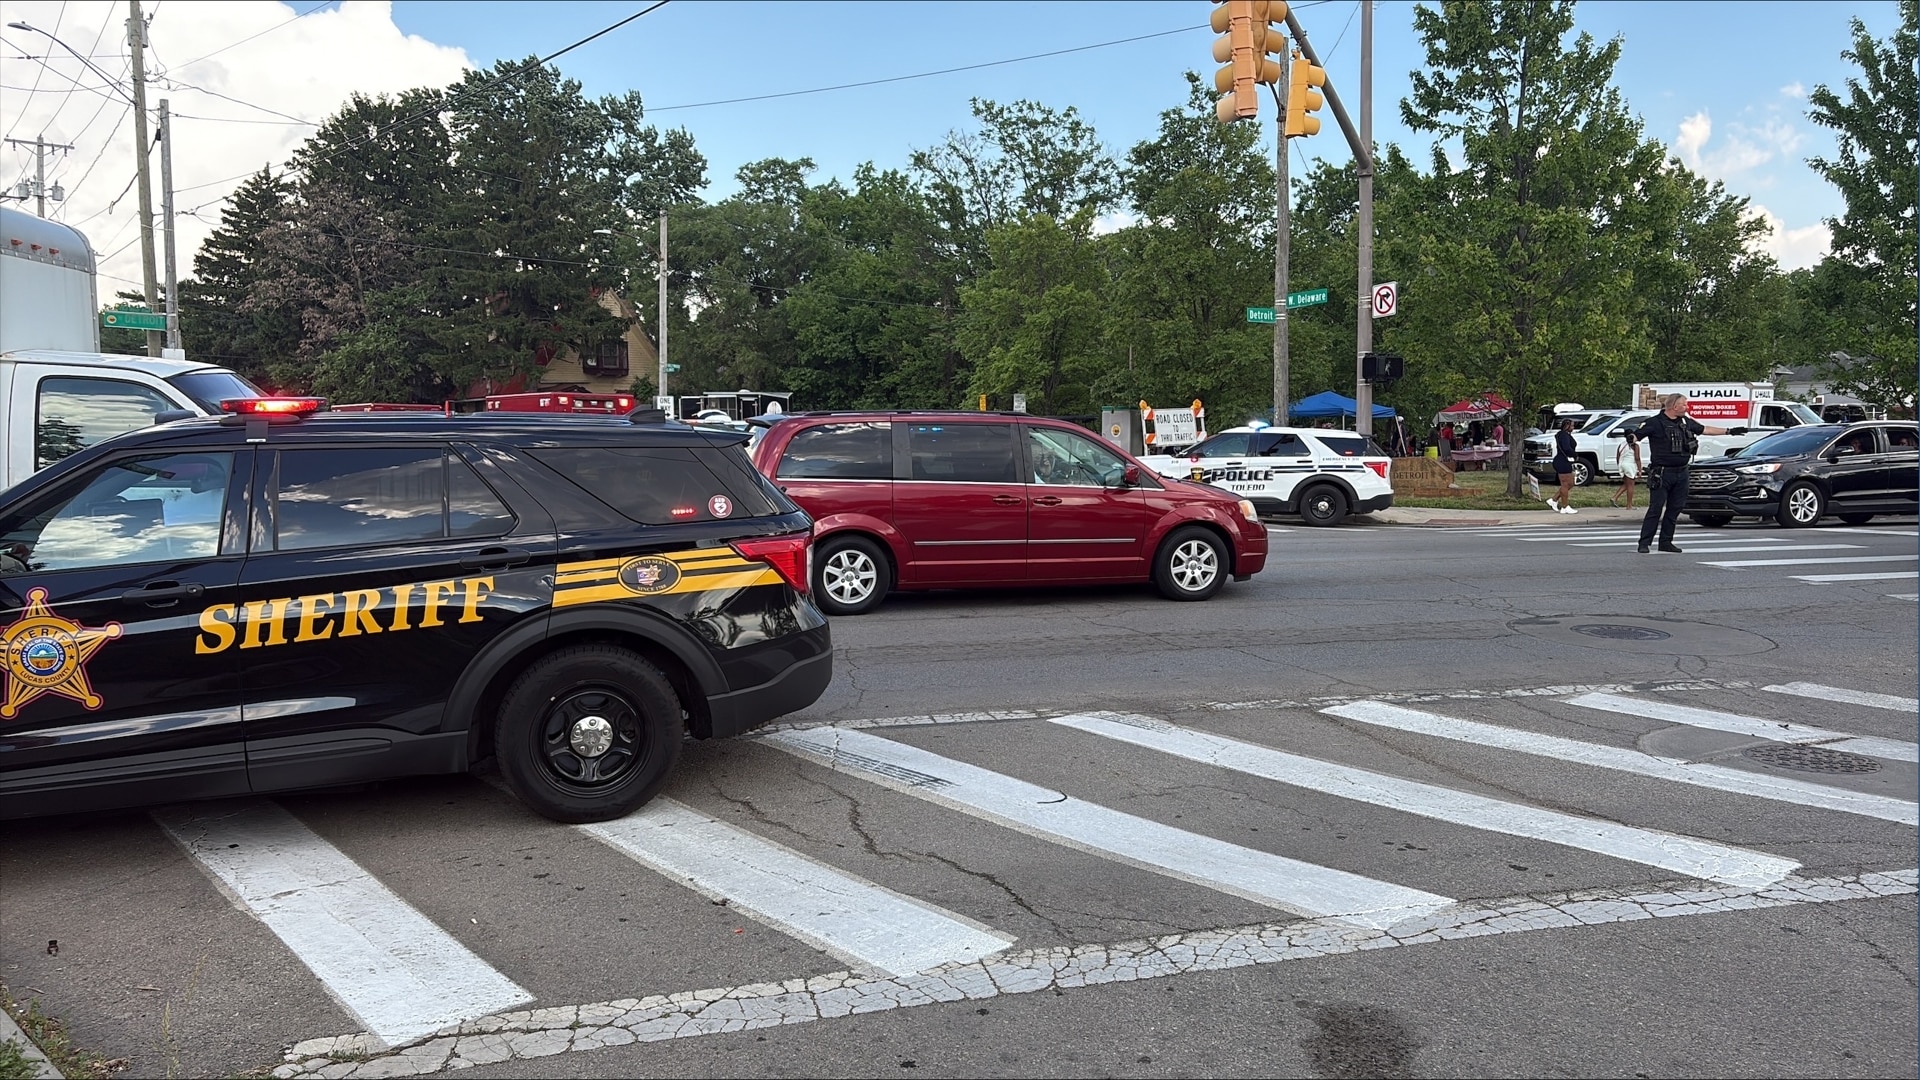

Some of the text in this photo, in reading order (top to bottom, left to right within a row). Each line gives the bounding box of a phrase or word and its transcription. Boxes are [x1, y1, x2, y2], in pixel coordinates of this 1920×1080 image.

[1288, 292, 1326, 306] W. Delaware
[124, 314, 164, 325] DETROIT
[1249, 310, 1273, 320] Detroit
[1156, 413, 1193, 424] ROAD CLOSED
[1173, 424, 1179, 432] TO
[1161, 433, 1193, 442] THRU TRAFFIC
[1210, 468, 1274, 482] POLICE
[1393, 471, 1430, 480] DETROIT
[195, 576, 496, 655] SHERIFF
[11, 628, 74, 655] SHERIFF
[20, 667, 71, 684] LUCAS COUNTY
